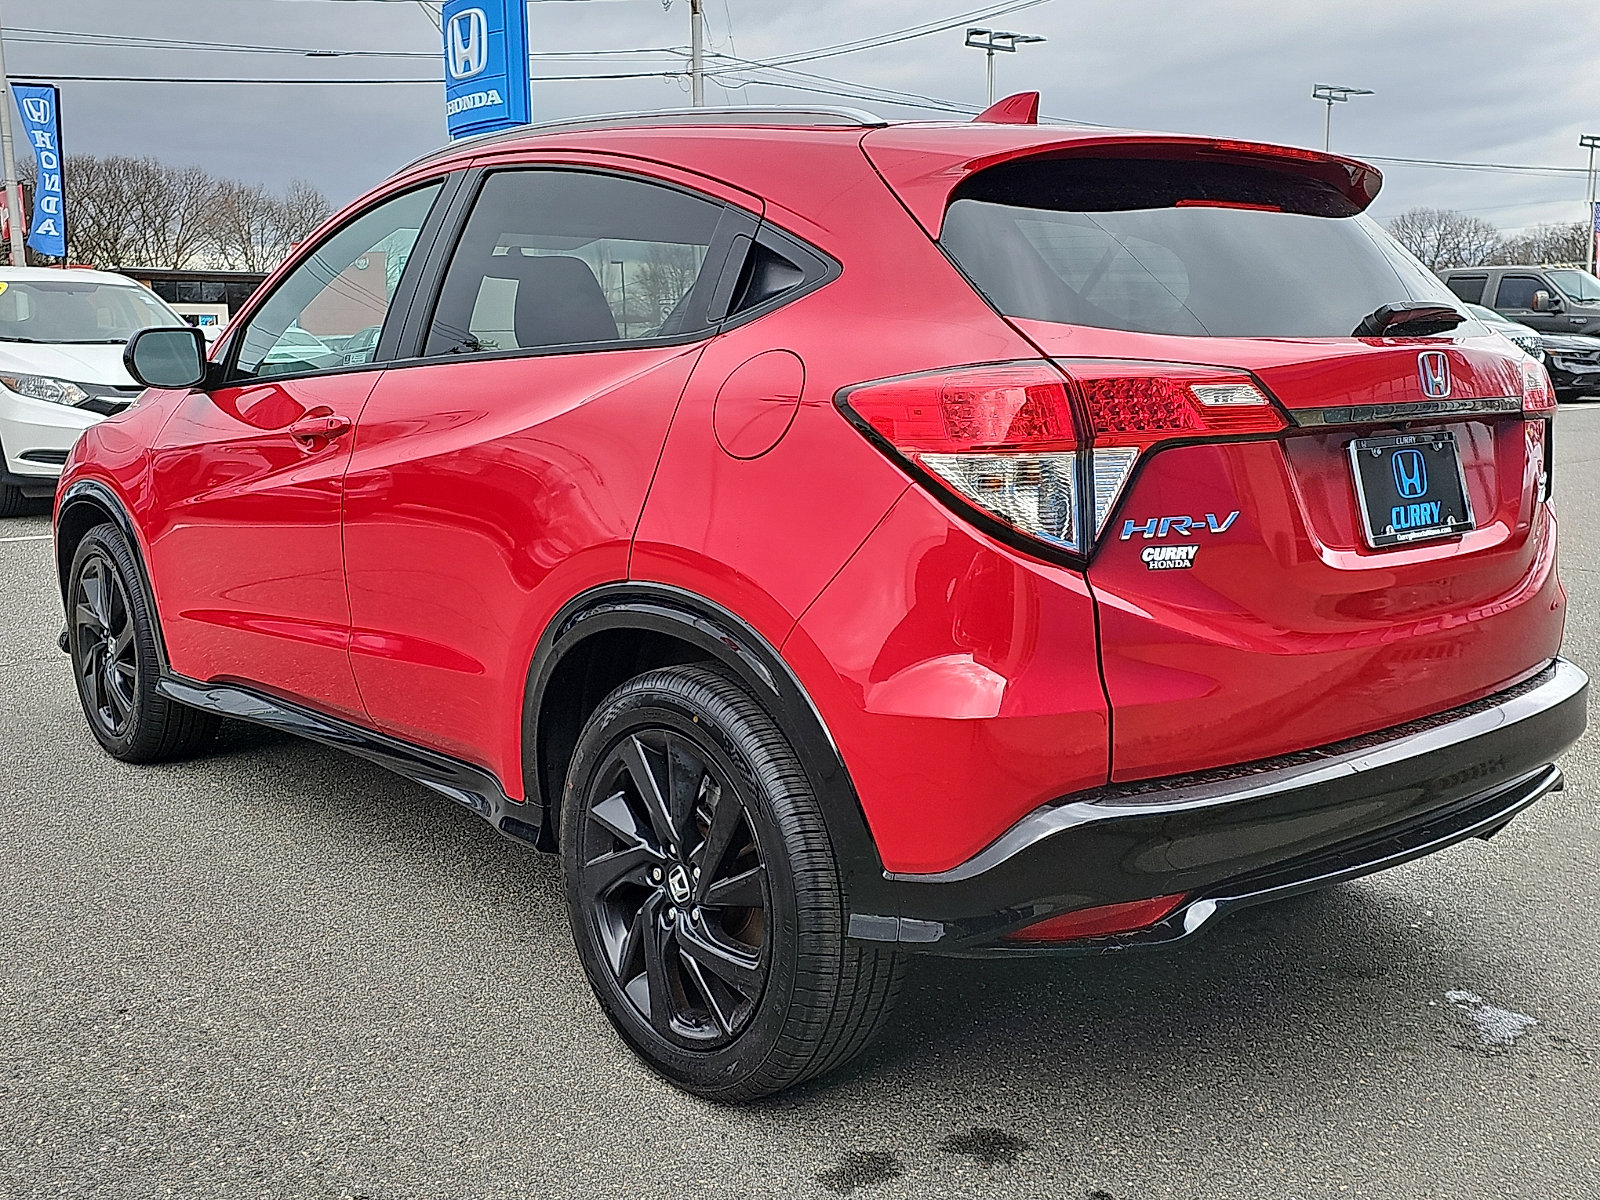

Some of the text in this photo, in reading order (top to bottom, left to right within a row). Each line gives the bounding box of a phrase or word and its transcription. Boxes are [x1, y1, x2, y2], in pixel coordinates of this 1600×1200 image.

[447, 89, 504, 116] HONDA
[1396, 436, 1417, 445] CURRY
[1119, 510, 1240, 541] HR-V
[1391, 500, 1441, 530] CURRY
[1141, 545, 1199, 562] CURRY
[1148, 559, 1192, 570] HONDA
